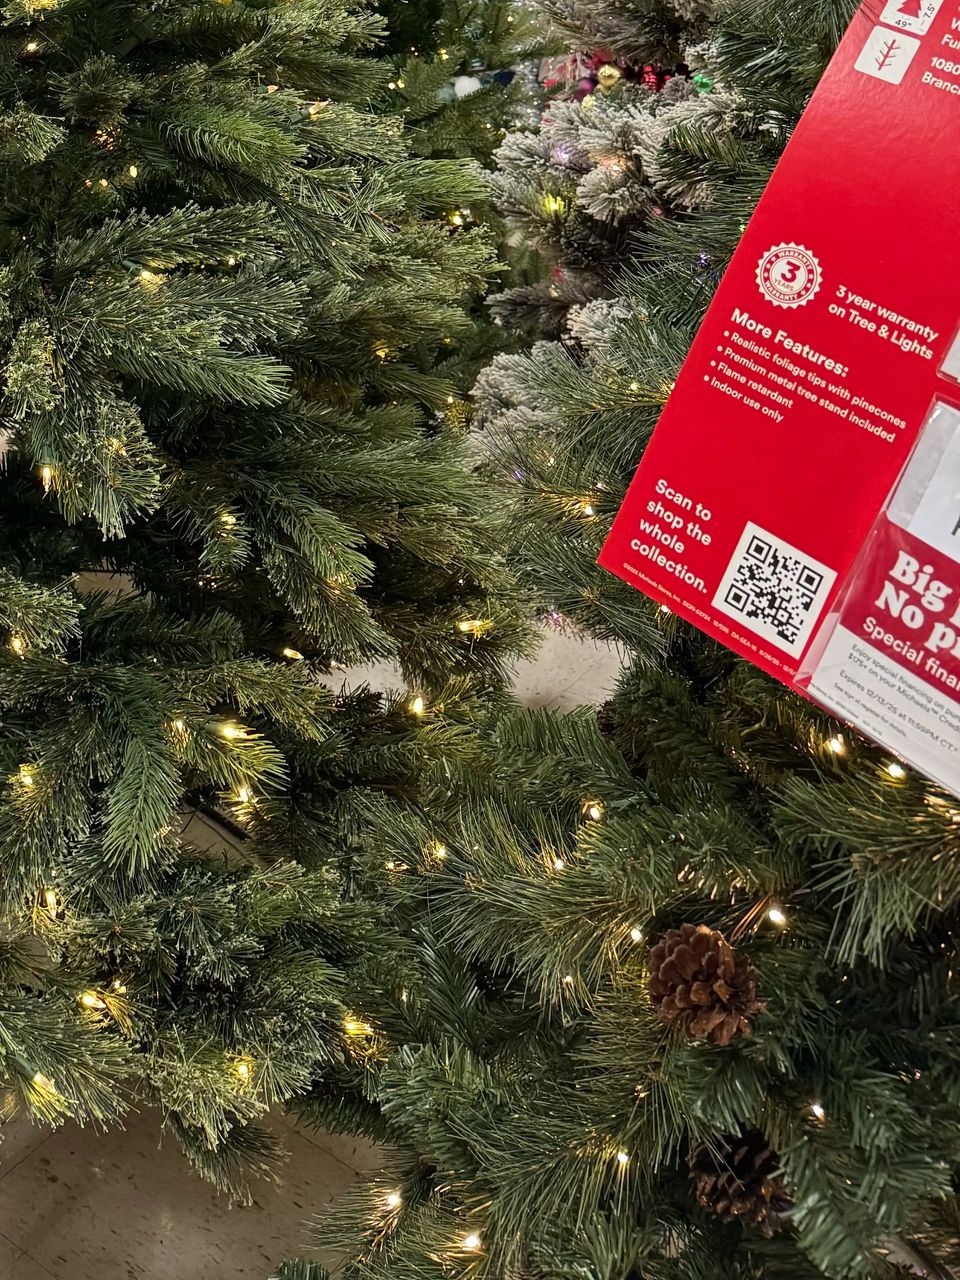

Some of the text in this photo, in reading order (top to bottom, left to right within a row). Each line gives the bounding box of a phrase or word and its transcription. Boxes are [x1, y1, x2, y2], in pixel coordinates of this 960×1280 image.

[774, 278, 794, 291] YEARS
[781, 260, 801, 282] 3
[828, 303, 934, 360] on Tree & Lights
[836, 284, 939, 343] 3 year warranty
[730, 308, 849, 378] More Features:
[710, 376, 785, 424] Indoor use only
[717, 362, 794, 409] Flame retardant
[724, 347, 896, 444] Premium metal tree stand included
[731, 332, 907, 430] Realistic foliage tips with pinecones
[646, 500, 712, 546] shop the
[655, 479, 712, 521] Scan to
[640, 518, 685, 553] whole
[630, 539, 708, 594] collection.
[889, 550, 953, 612] Big
[874, 580, 925, 629] No
[863, 616, 925, 665] Special
[840, 669, 865, 692] Expires
[898, 711, 907, 720] at
[851, 643, 945, 710] Enjoy special financing on
[868, 667, 897, 690] on your
